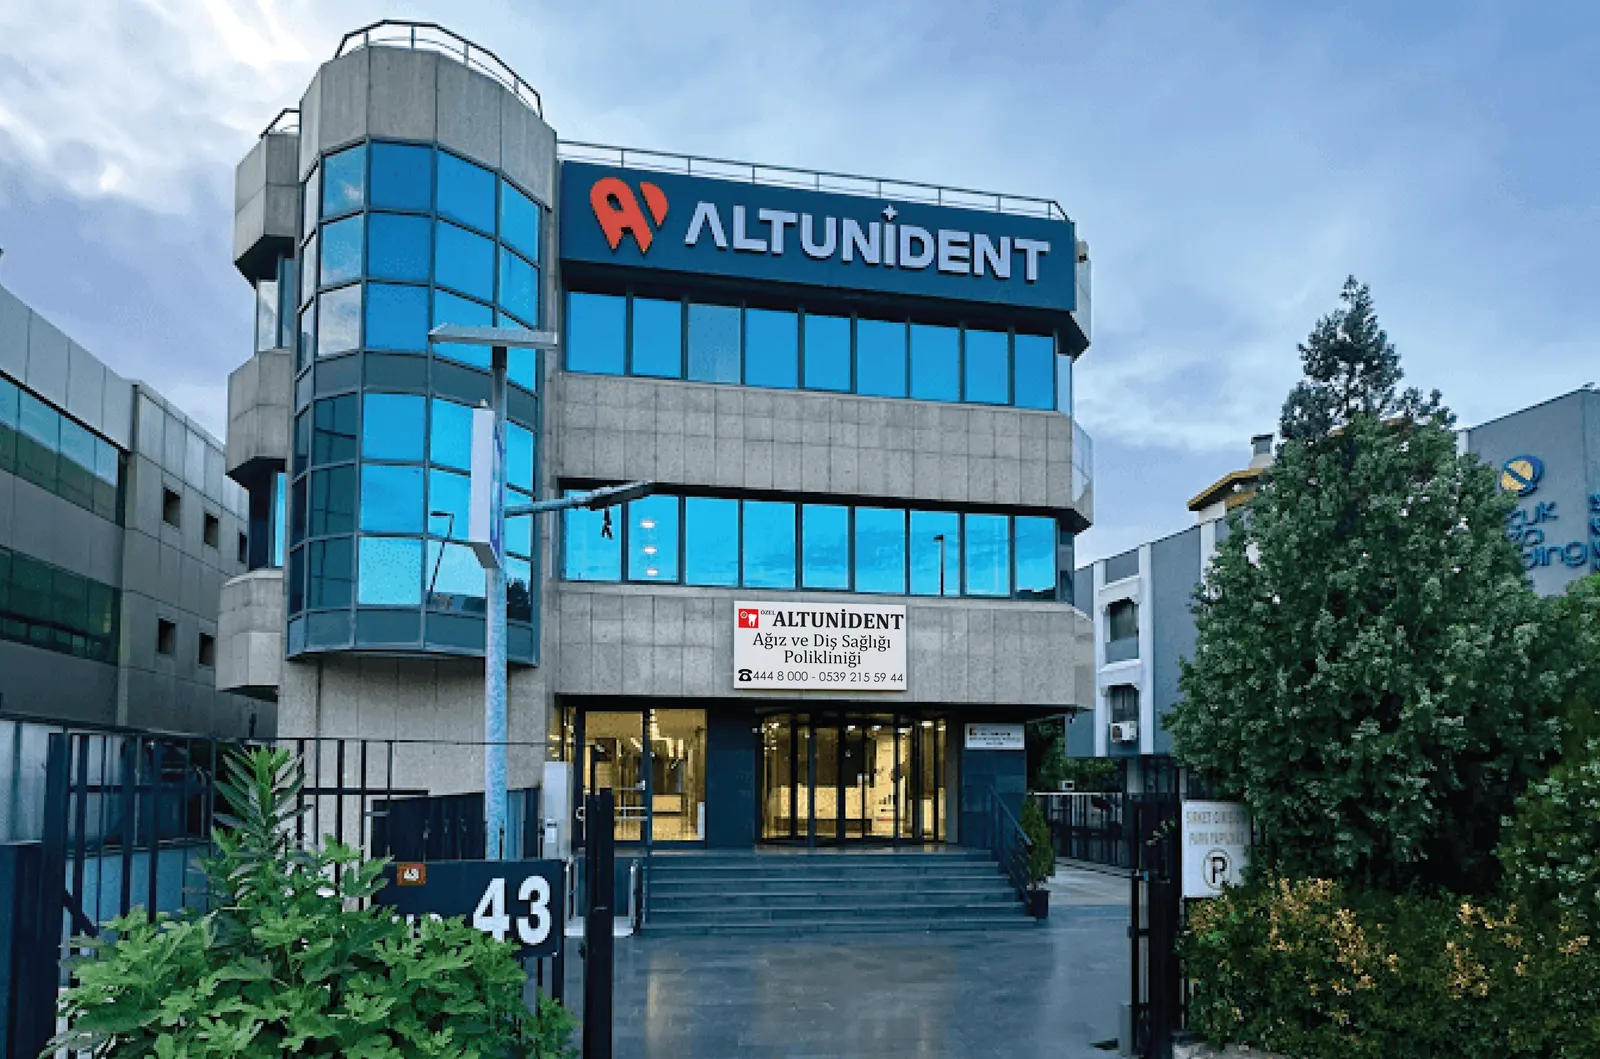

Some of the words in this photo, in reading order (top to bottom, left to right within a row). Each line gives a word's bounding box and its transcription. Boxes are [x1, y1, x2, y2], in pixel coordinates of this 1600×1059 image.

[772, 609, 904, 630] ALTUNİDENT
[752, 632, 787, 650] Ağız
[791, 636, 809, 647] ve
[813, 634, 837, 651] Diş
[842, 634, 891, 652] Sağlığı
[784, 650, 862, 668] Polikliniği
[753, 671, 774, 681] 444
[777, 671, 784, 681] 8
[787, 671, 808, 682] 000
[819, 672, 847, 682] 0539
[849, 672, 870, 683] 215
[873, 673, 887, 683] 59
[890, 673, 904, 683] 44
[472, 875, 552, 945] 43
